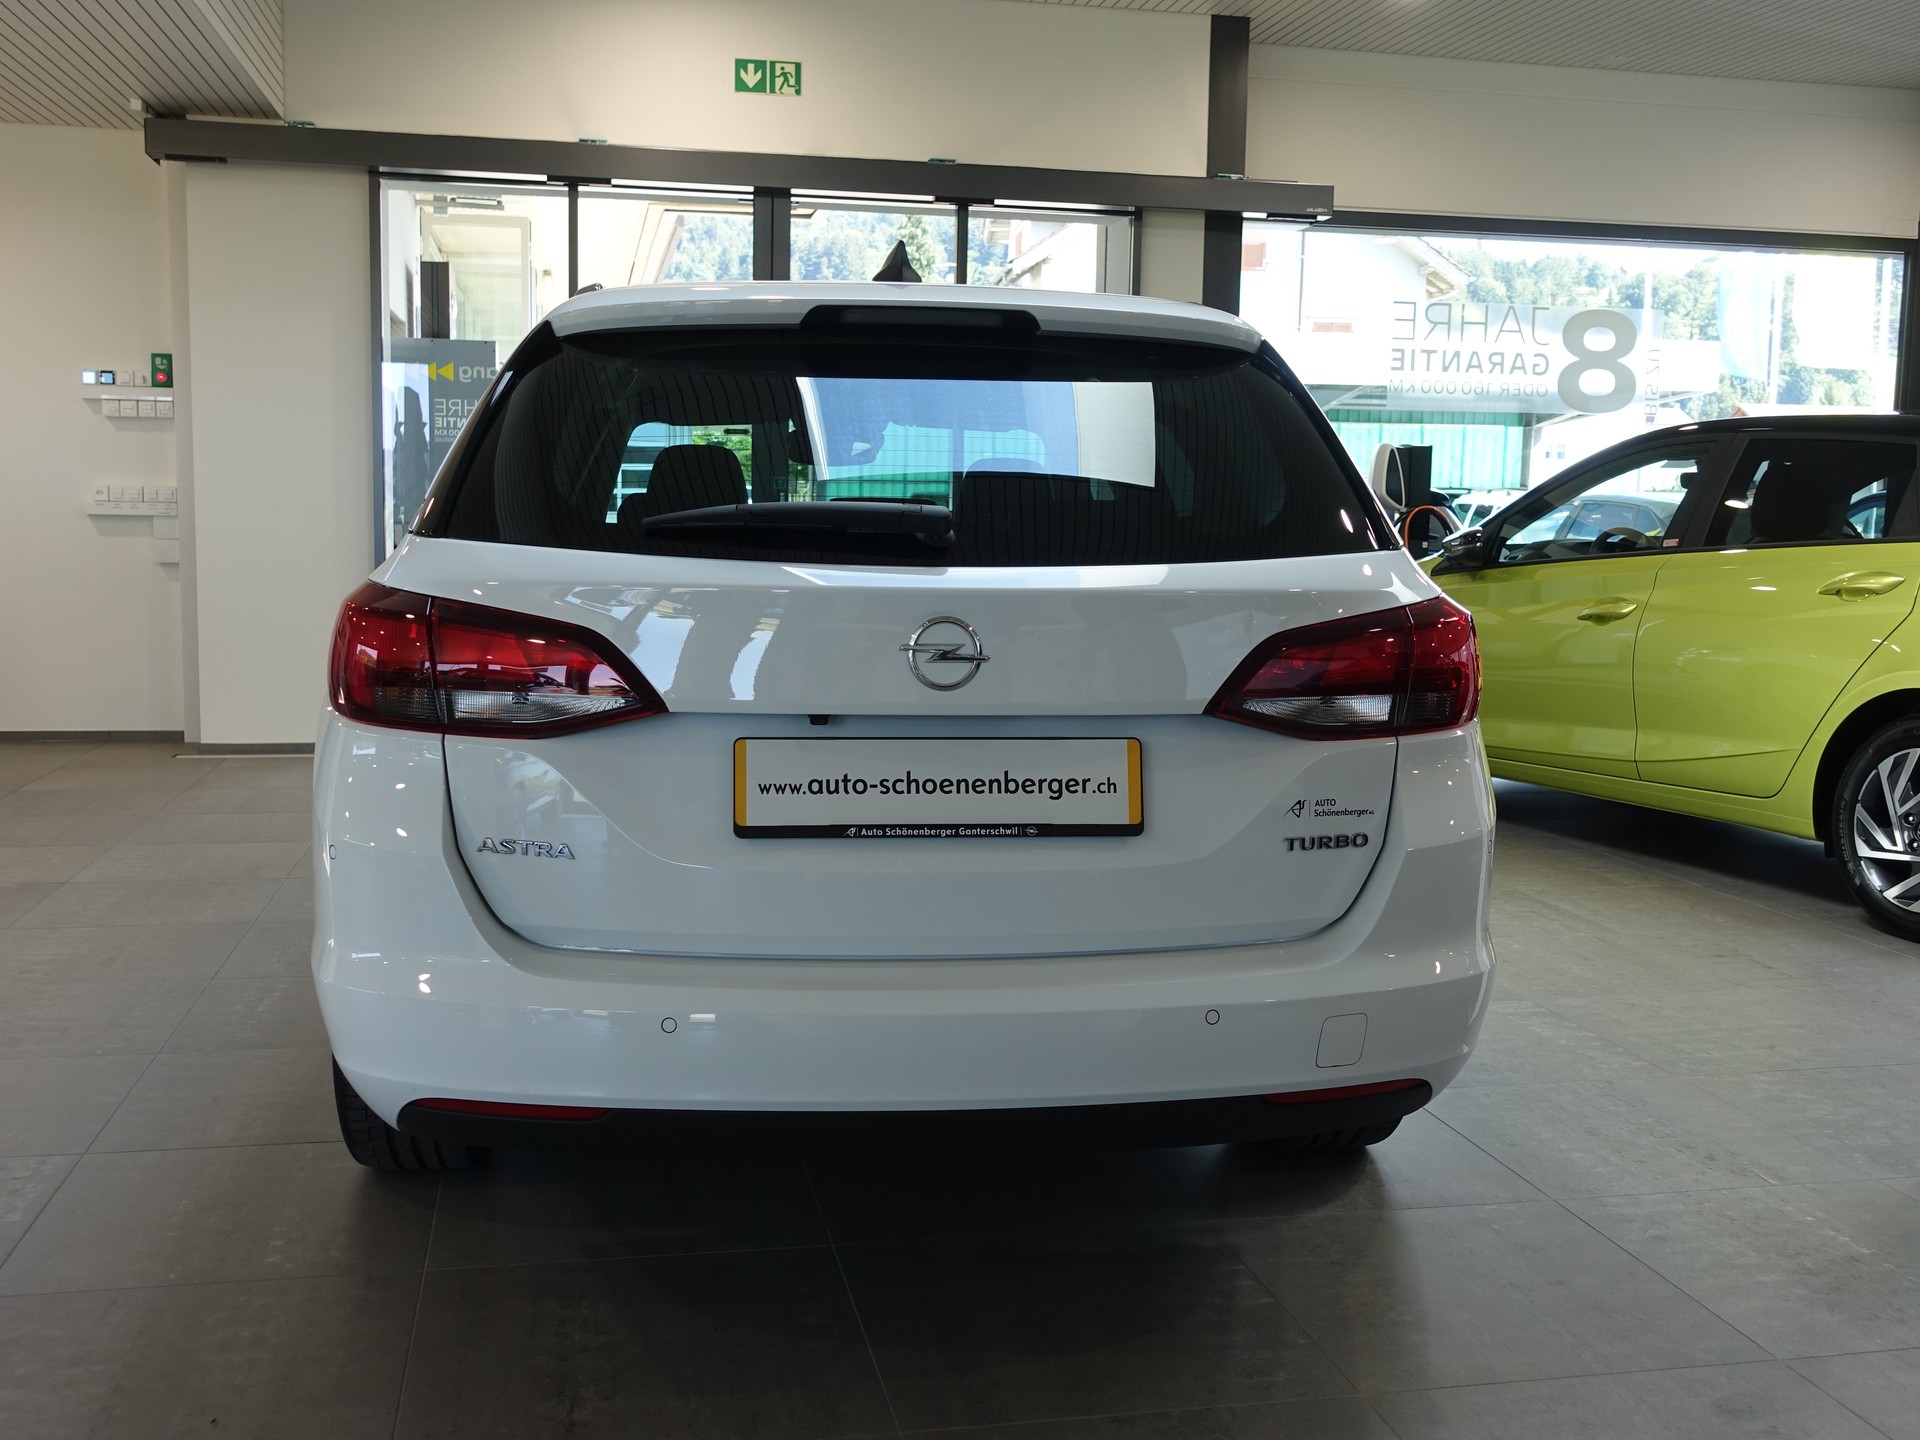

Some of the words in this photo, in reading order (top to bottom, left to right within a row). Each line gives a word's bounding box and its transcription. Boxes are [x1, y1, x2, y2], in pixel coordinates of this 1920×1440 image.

[757, 770, 1118, 800] www.auto-schoenenberger.ch
[1314, 798, 1336, 807] AUTO
[1314, 807, 1369, 818] Schönenberger
[861, 827, 883, 837] Auto
[885, 826, 956, 838] Schönenberger
[958, 826, 1018, 836] Ganterschwil
[477, 837, 576, 860] ASTRA
[1283, 832, 1369, 852] TURBO
